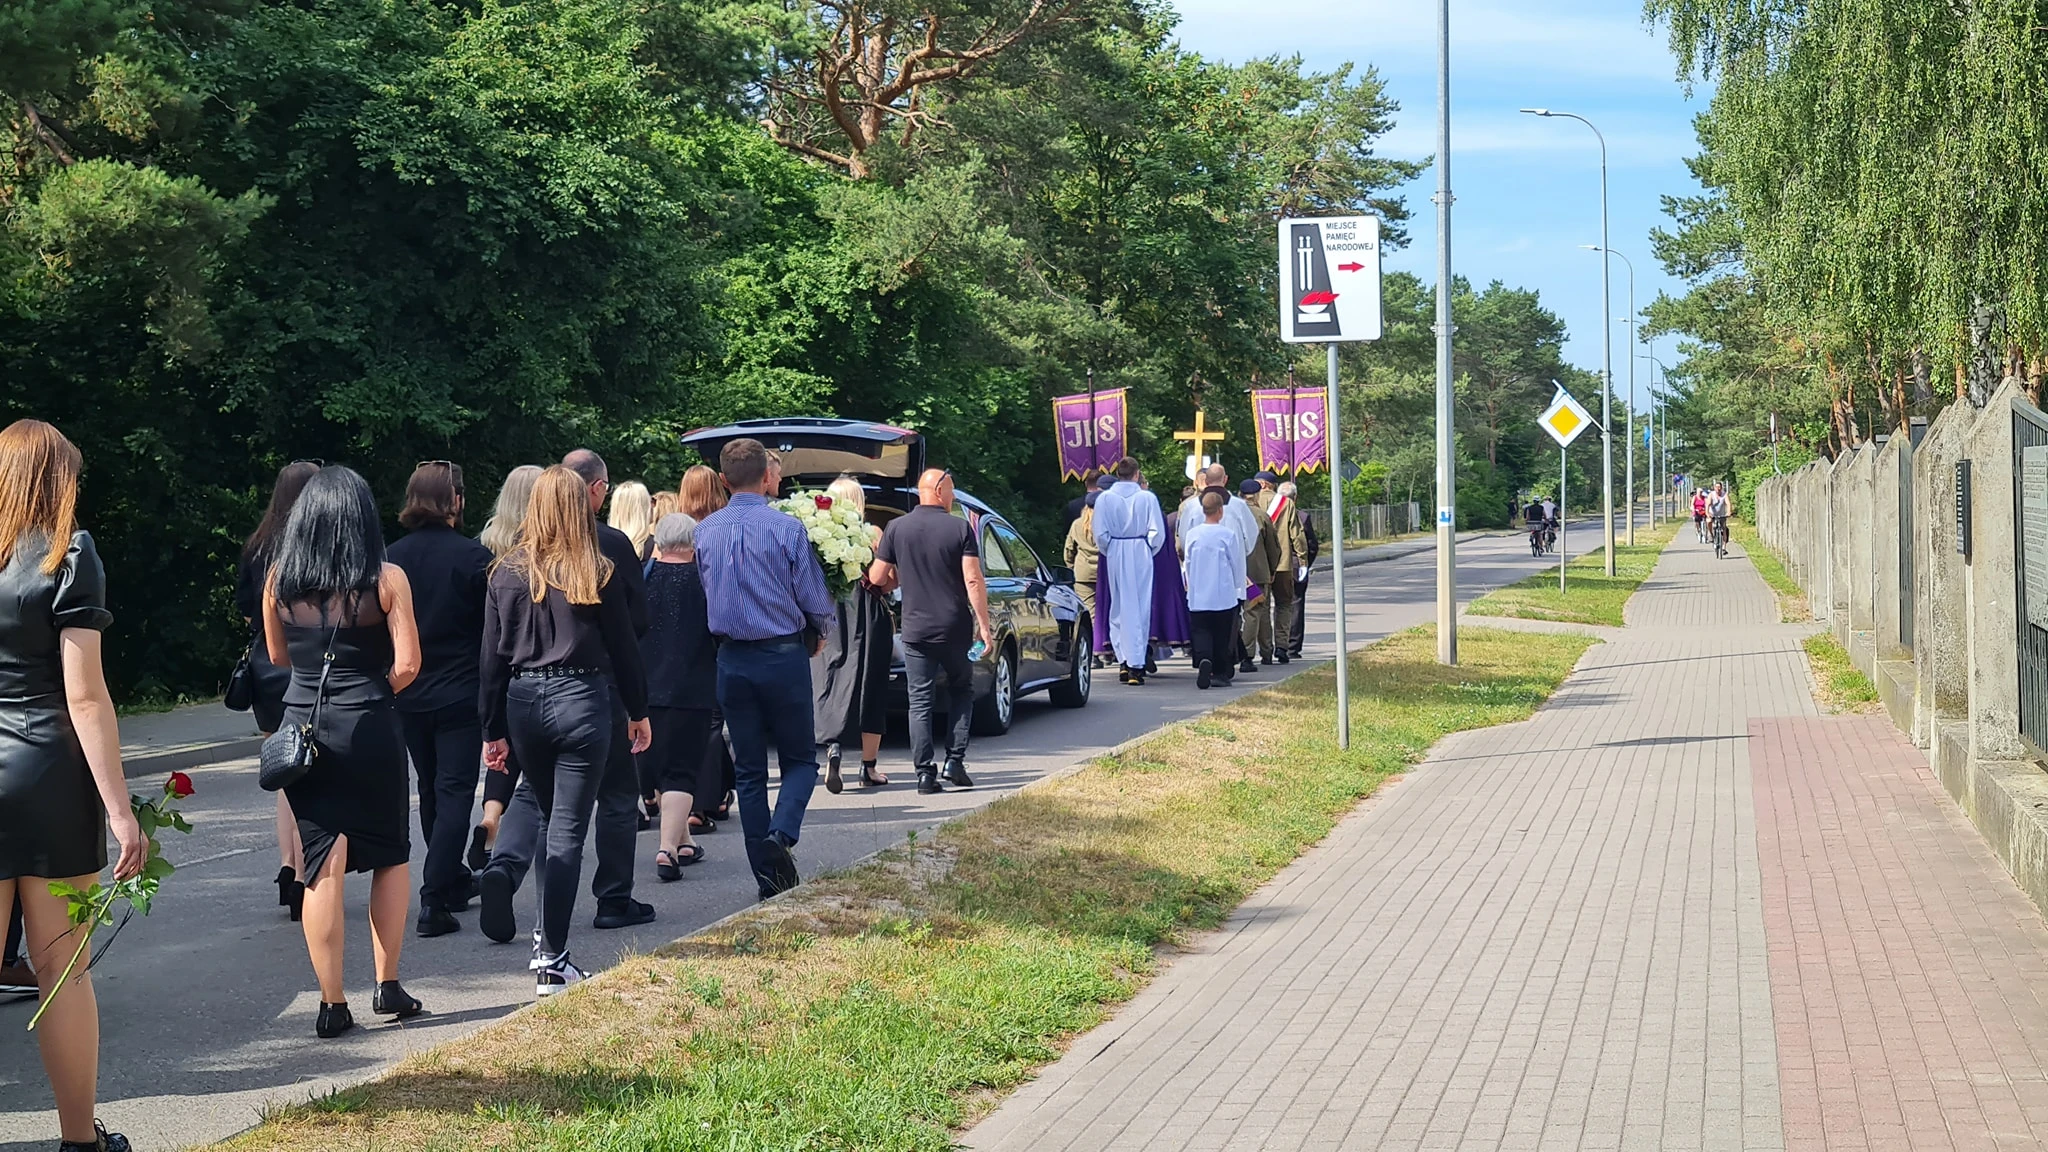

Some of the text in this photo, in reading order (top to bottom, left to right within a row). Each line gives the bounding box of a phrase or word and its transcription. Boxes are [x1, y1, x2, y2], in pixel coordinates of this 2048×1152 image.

[1326, 222, 1357, 230] MIEJSCE
[1326, 232, 1356, 241] PAMIĘCI
[1326, 243, 1373, 251] NARODOWEJ
